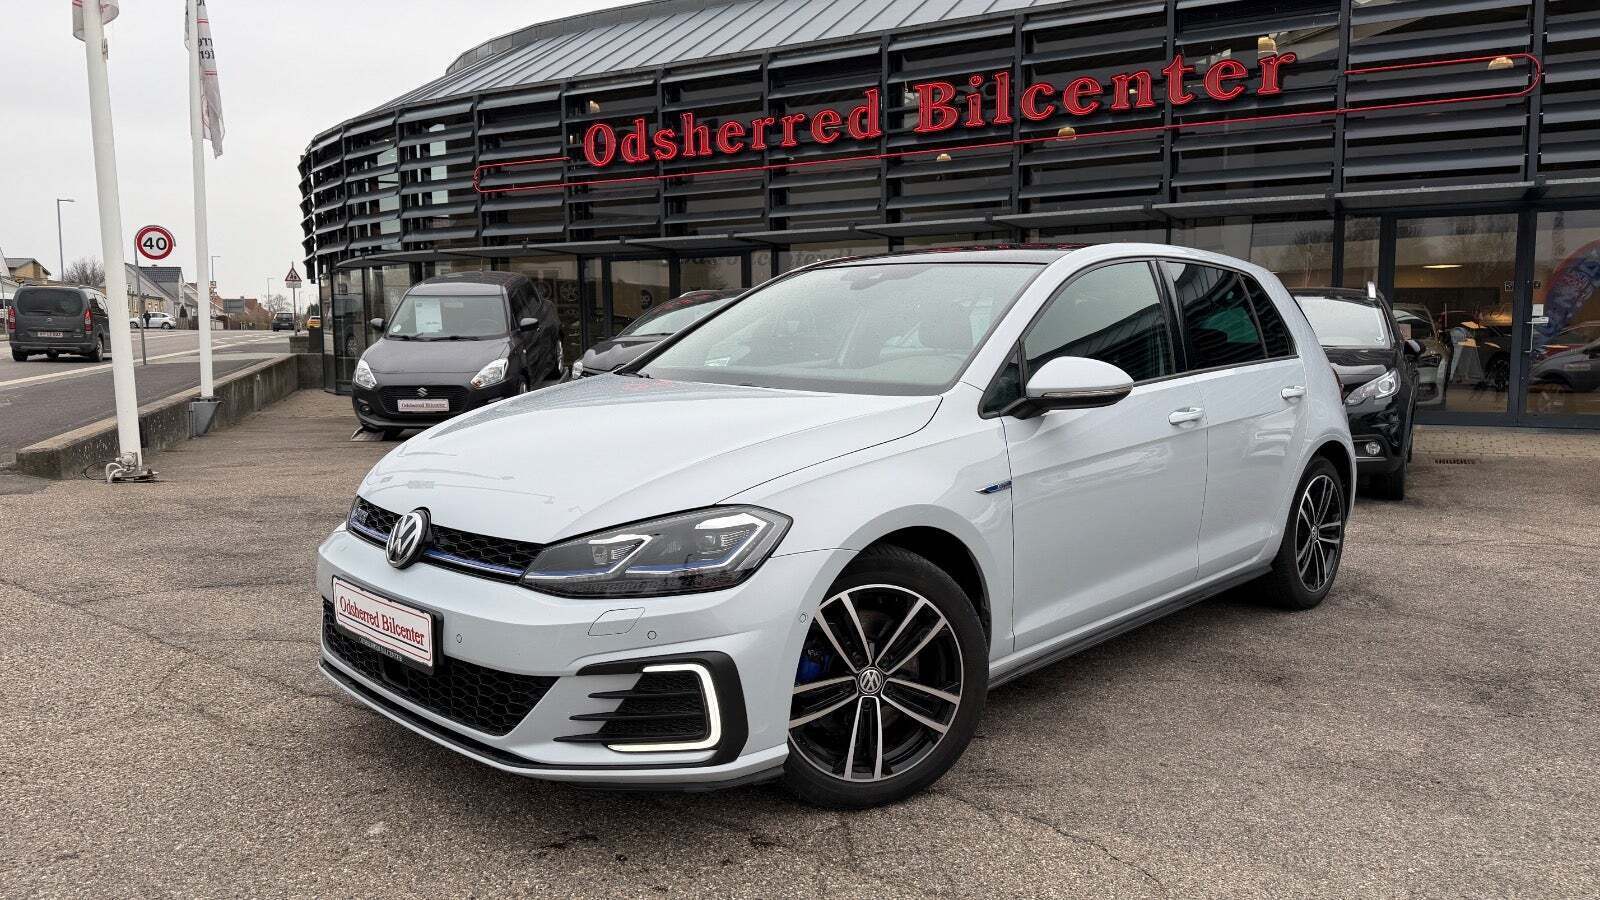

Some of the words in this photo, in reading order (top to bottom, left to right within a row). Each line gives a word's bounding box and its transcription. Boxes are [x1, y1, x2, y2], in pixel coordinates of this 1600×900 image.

[583, 87, 883, 168] Odsherred
[912, 50, 1298, 134] Bilcenter
[143, 236, 167, 251] 40
[339, 595, 380, 628] Odsherred
[381, 613, 425, 646] Bilcenter
